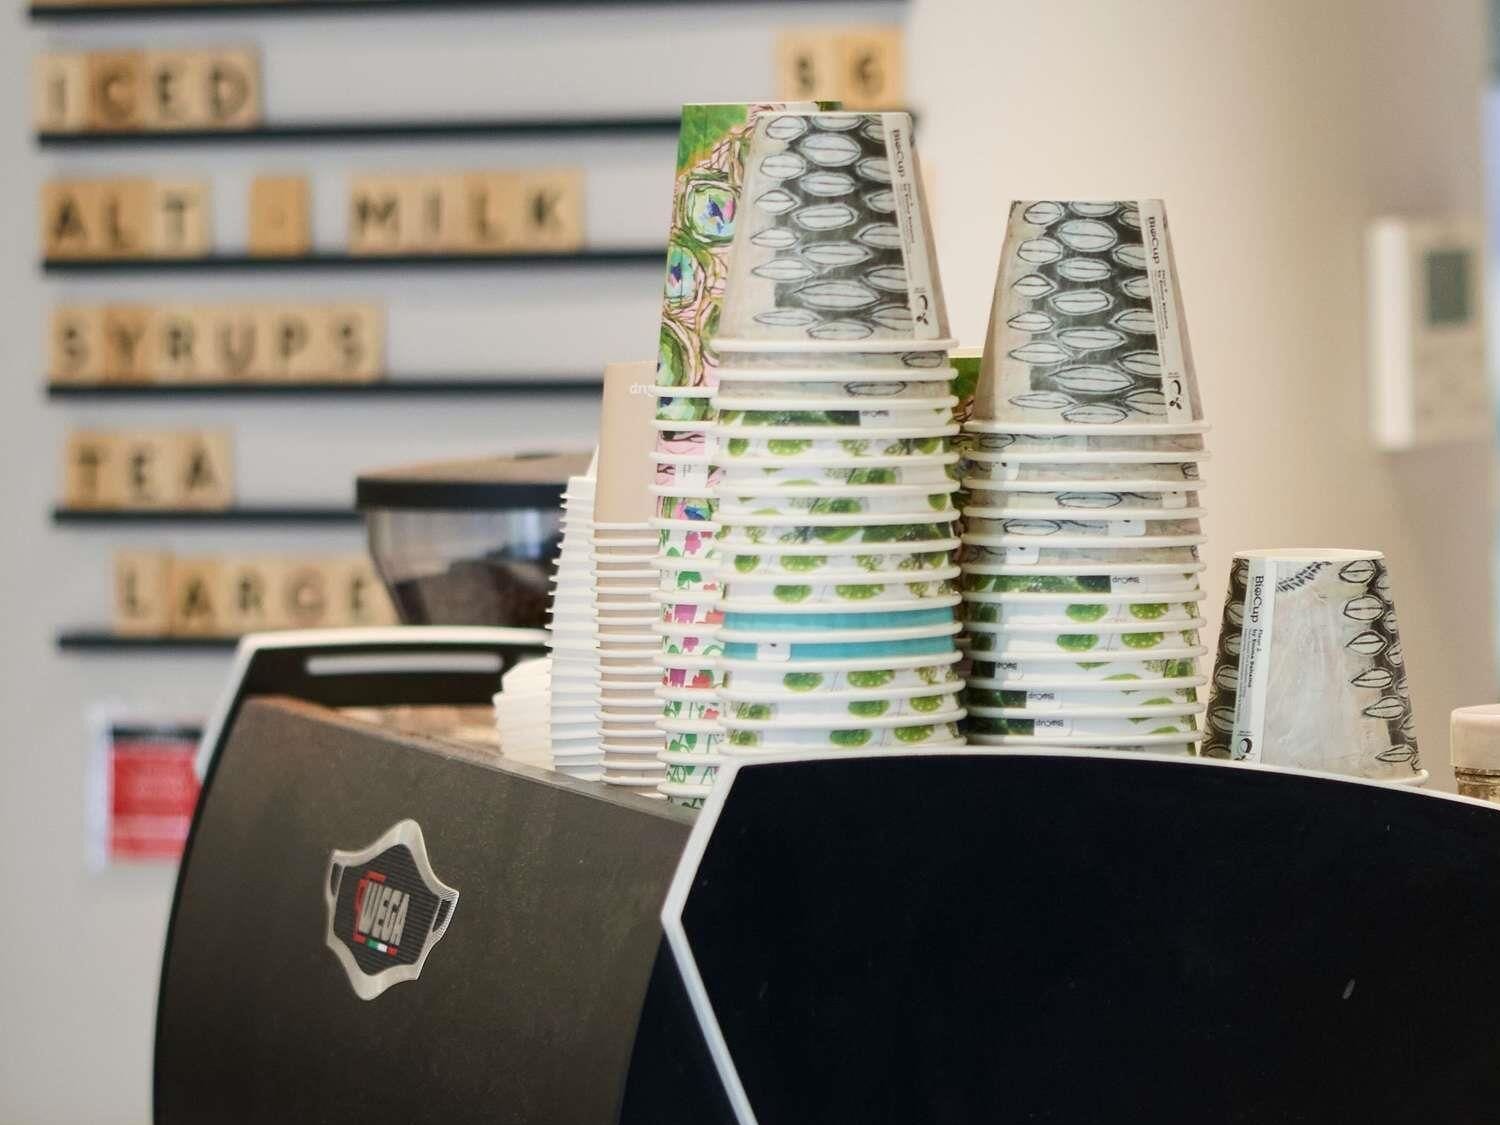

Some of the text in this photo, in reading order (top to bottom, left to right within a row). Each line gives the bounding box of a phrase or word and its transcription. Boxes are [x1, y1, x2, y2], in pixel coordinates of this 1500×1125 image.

[51, 60, 252, 122] ICED
[53, 186, 564, 248] ALT MILK
[58, 313, 362, 374] SYRUPS
[78, 440, 218, 500] TEA
[1249, 575, 1264, 623] BioCup
